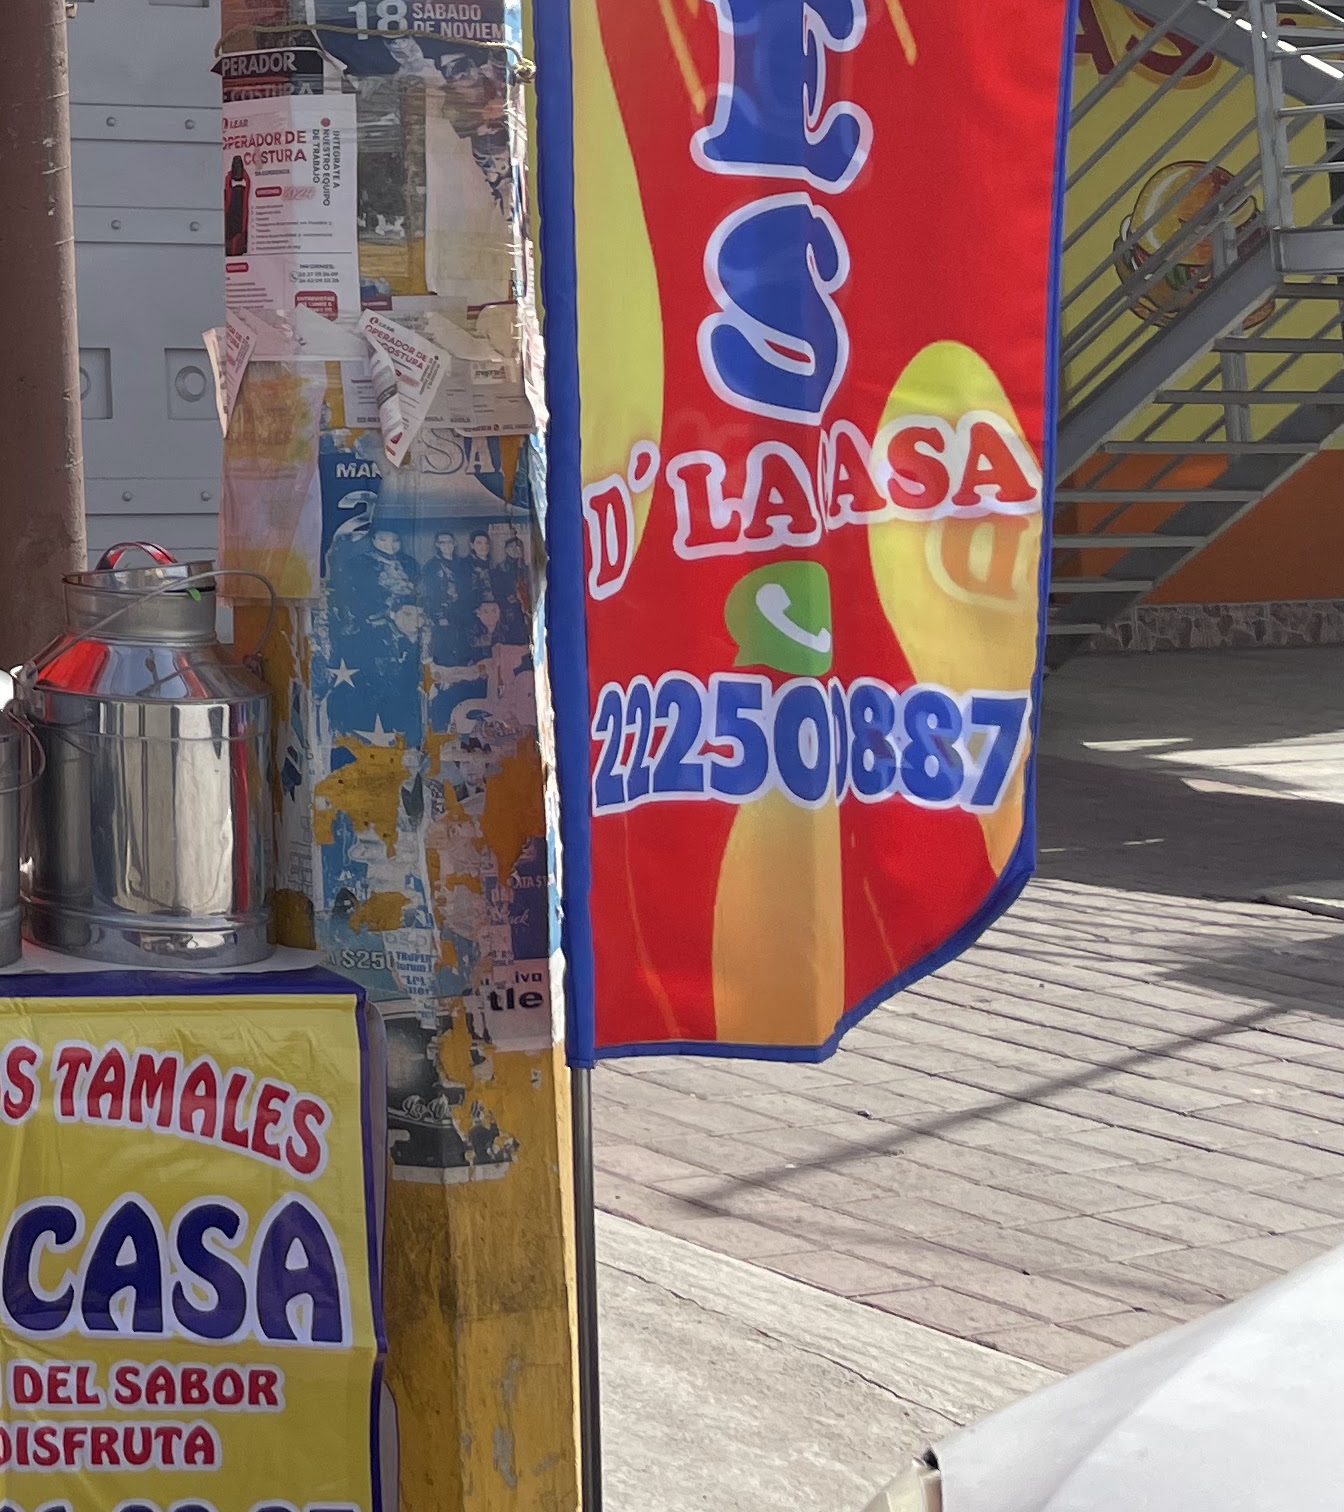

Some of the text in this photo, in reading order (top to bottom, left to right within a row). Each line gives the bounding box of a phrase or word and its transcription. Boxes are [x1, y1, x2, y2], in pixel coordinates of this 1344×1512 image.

[348, 0, 408, 40] 18
[412, 0, 481, 20] SÁBADO
[222, 52, 297, 76] PERADOR
[285, 130, 306, 144] DE
[313, 129, 319, 140] DE
[322, 172, 330, 206] EQUIPO
[824, 422, 1037, 518] ASA
[57, 1046, 325, 1175] TAMALES
[2, 1200, 345, 1343] CASA
[14, 1364, 100, 1406] DEL
[114, 1364, 278, 1405] SABOR
